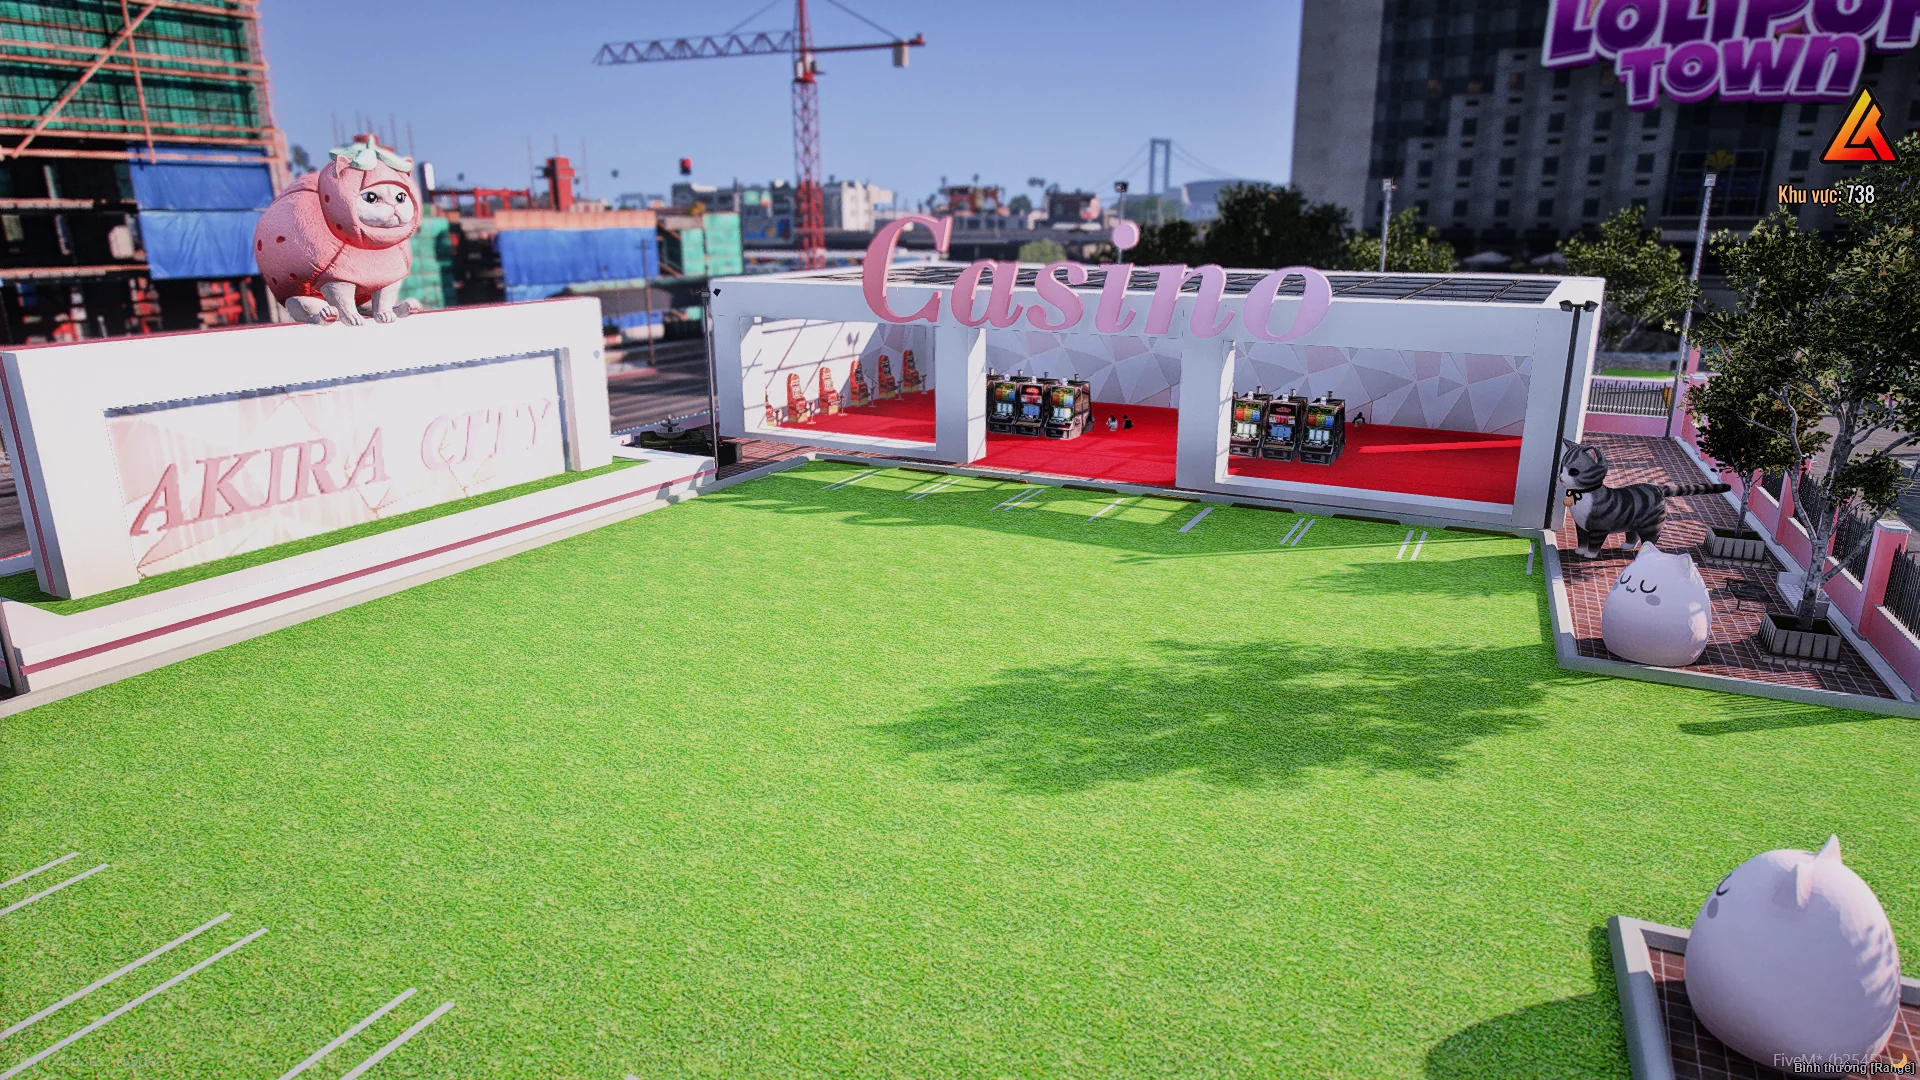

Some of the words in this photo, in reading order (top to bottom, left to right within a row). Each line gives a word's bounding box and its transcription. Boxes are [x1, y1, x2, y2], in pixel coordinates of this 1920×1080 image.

[861, 213, 1333, 343] Casino
[129, 425, 392, 537] AKIRA
[419, 395, 552, 472] CITY
